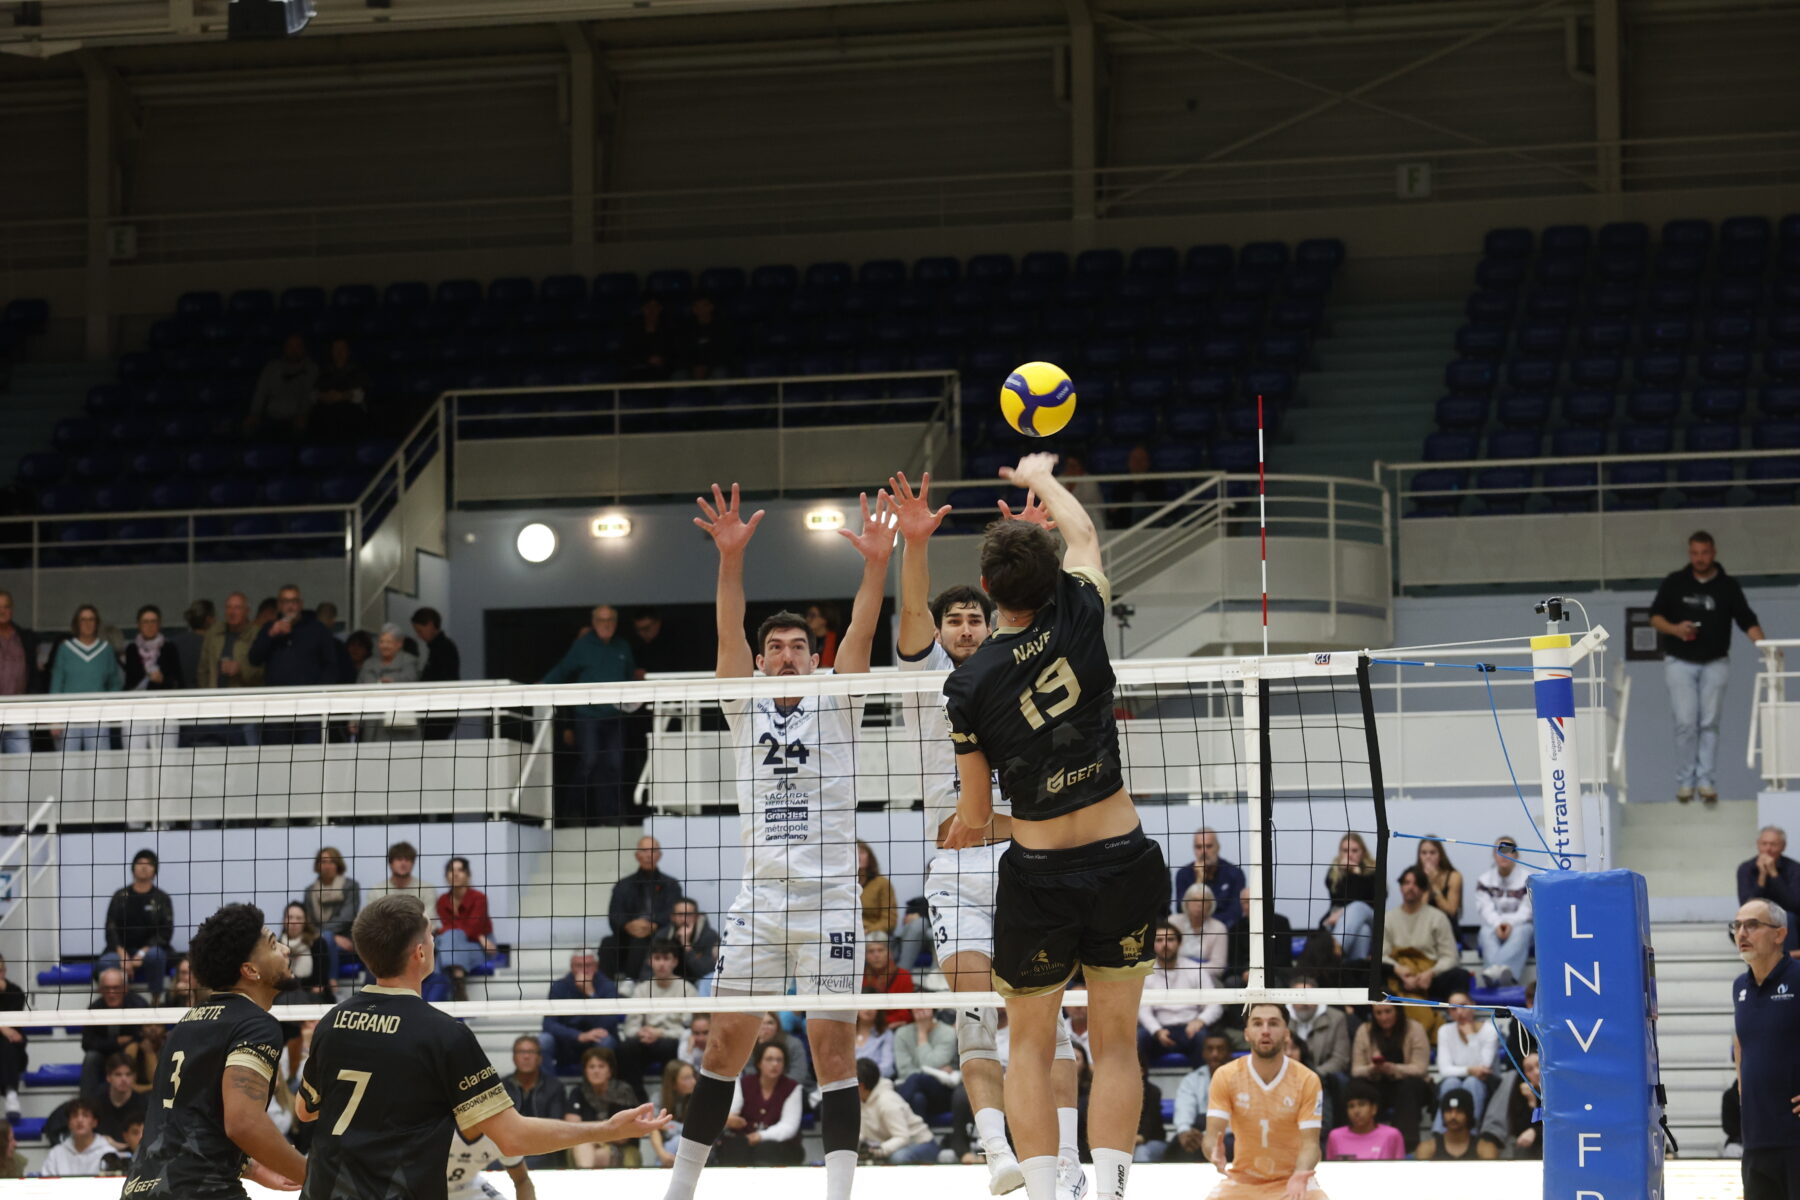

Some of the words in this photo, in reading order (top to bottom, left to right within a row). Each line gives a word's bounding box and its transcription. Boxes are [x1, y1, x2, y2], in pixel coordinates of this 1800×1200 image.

[1019, 657, 1082, 731] 19
[759, 732, 809, 765] 24
[934, 926, 948, 949] 23
[809, 973, 854, 989] Maxéville
[333, 1010, 401, 1034] LEGRAND
[162, 1051, 185, 1109] 3
[331, 1069, 373, 1136] 7
[1260, 1119, 1269, 1148] 1
[134, 1177, 162, 1192] GEFF
[1117, 1164, 1125, 1191] CRAFT
